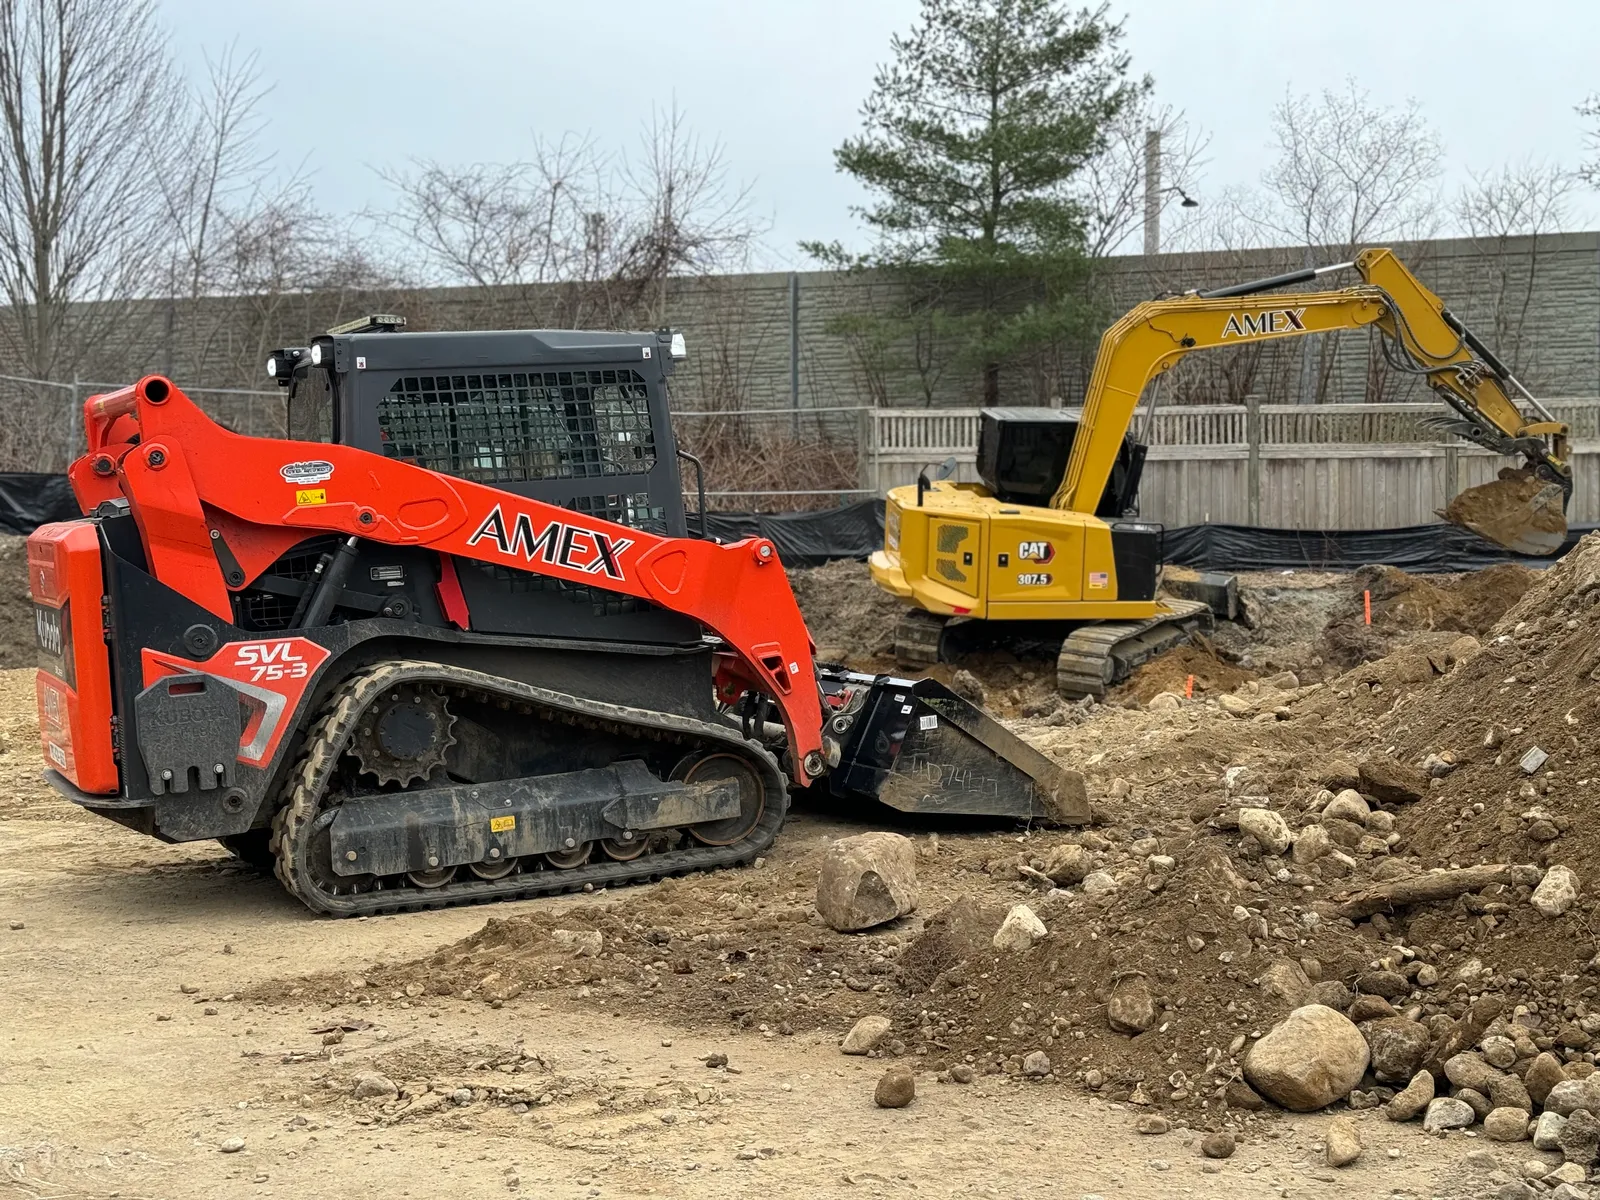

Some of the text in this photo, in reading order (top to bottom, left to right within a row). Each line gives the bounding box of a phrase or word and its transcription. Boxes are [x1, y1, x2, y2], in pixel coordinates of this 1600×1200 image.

[1221, 307, 1307, 339] AMEX
[466, 502, 636, 582] AMEX
[1019, 541, 1048, 559] CAT
[1017, 574, 1048, 585] 307.5
[234, 642, 303, 666] SVL
[250, 662, 308, 682] 75-3
[150, 697, 230, 727] KUBOTA
